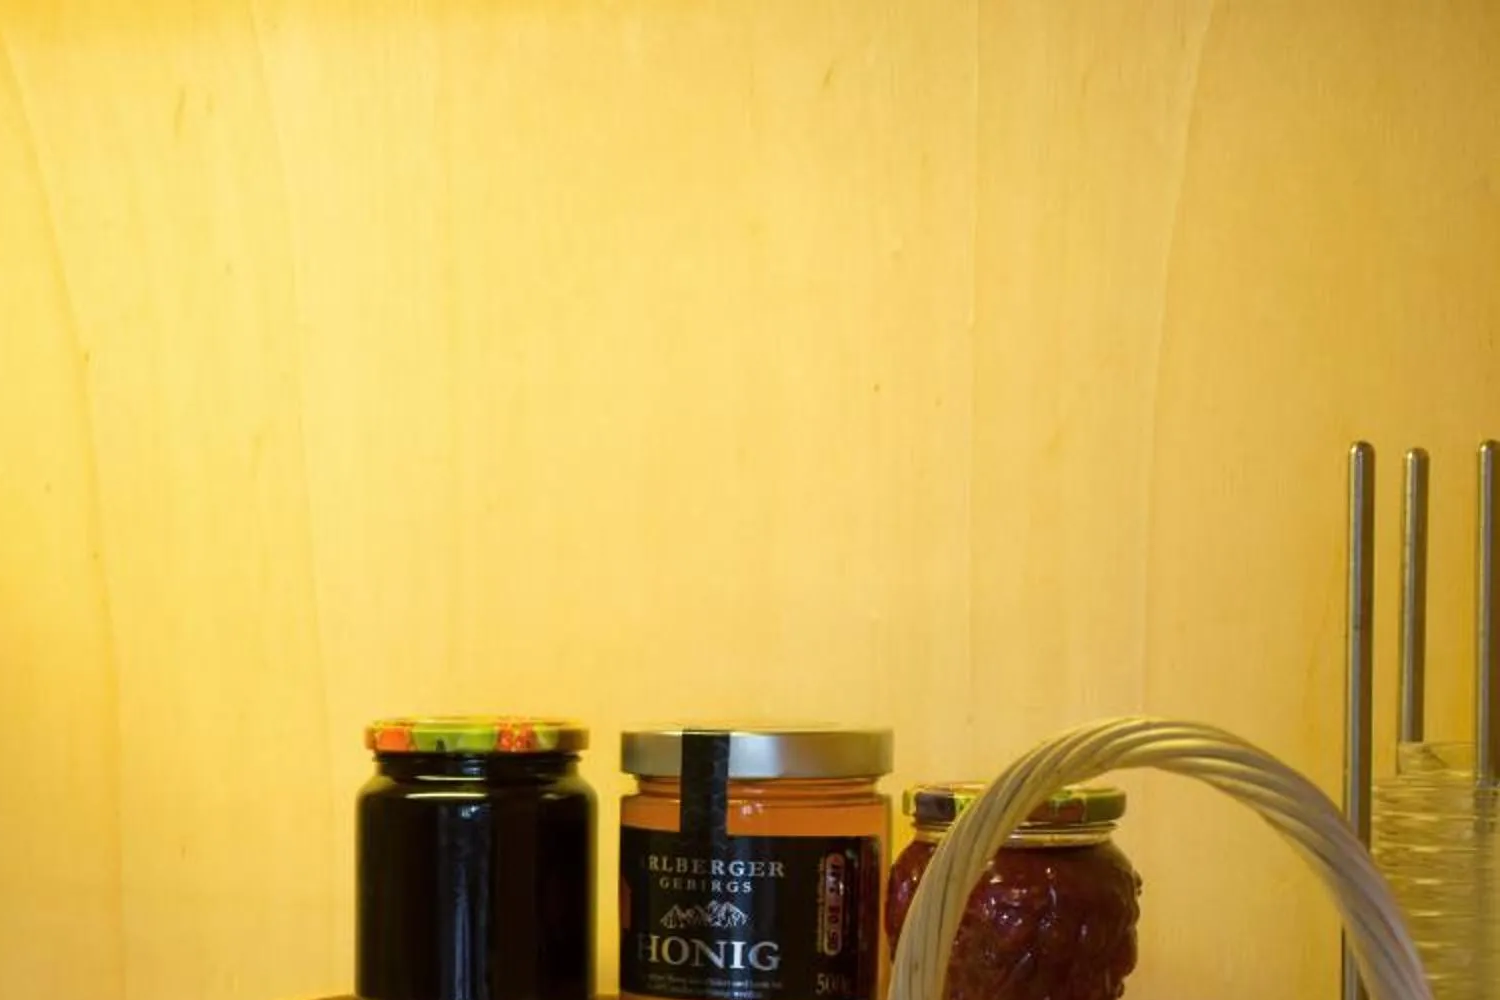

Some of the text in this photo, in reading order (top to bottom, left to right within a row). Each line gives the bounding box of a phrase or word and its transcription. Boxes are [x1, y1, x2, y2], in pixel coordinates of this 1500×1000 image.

[643, 854, 785, 878] RLBERGER
[659, 876, 753, 893] GEBIRGS
[637, 933, 781, 971] HONIG
